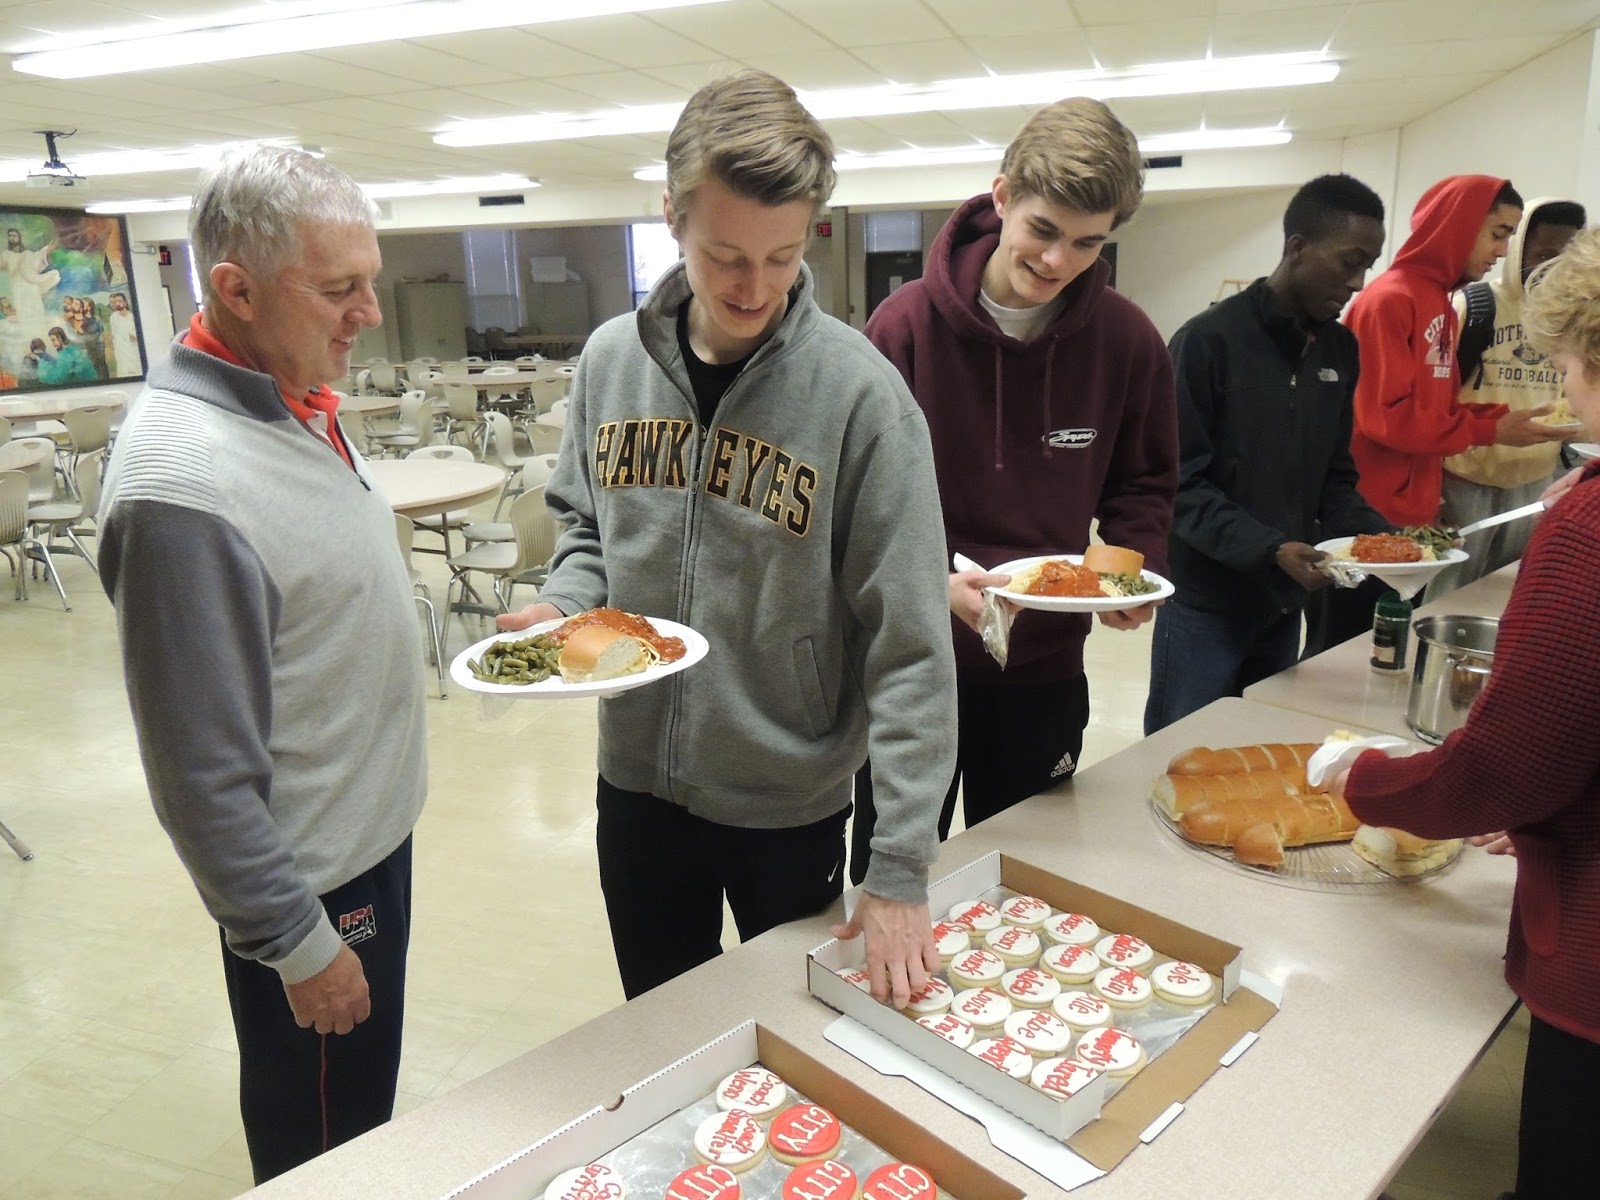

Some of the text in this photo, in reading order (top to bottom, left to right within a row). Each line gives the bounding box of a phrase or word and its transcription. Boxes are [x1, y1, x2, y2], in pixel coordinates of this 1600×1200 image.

[962, 986, 1008, 1016] Louis
[1017, 1009, 1065, 1039] Gabe
[745, 1074, 784, 1106] Coach
[777, 1106, 834, 1152] CITY
